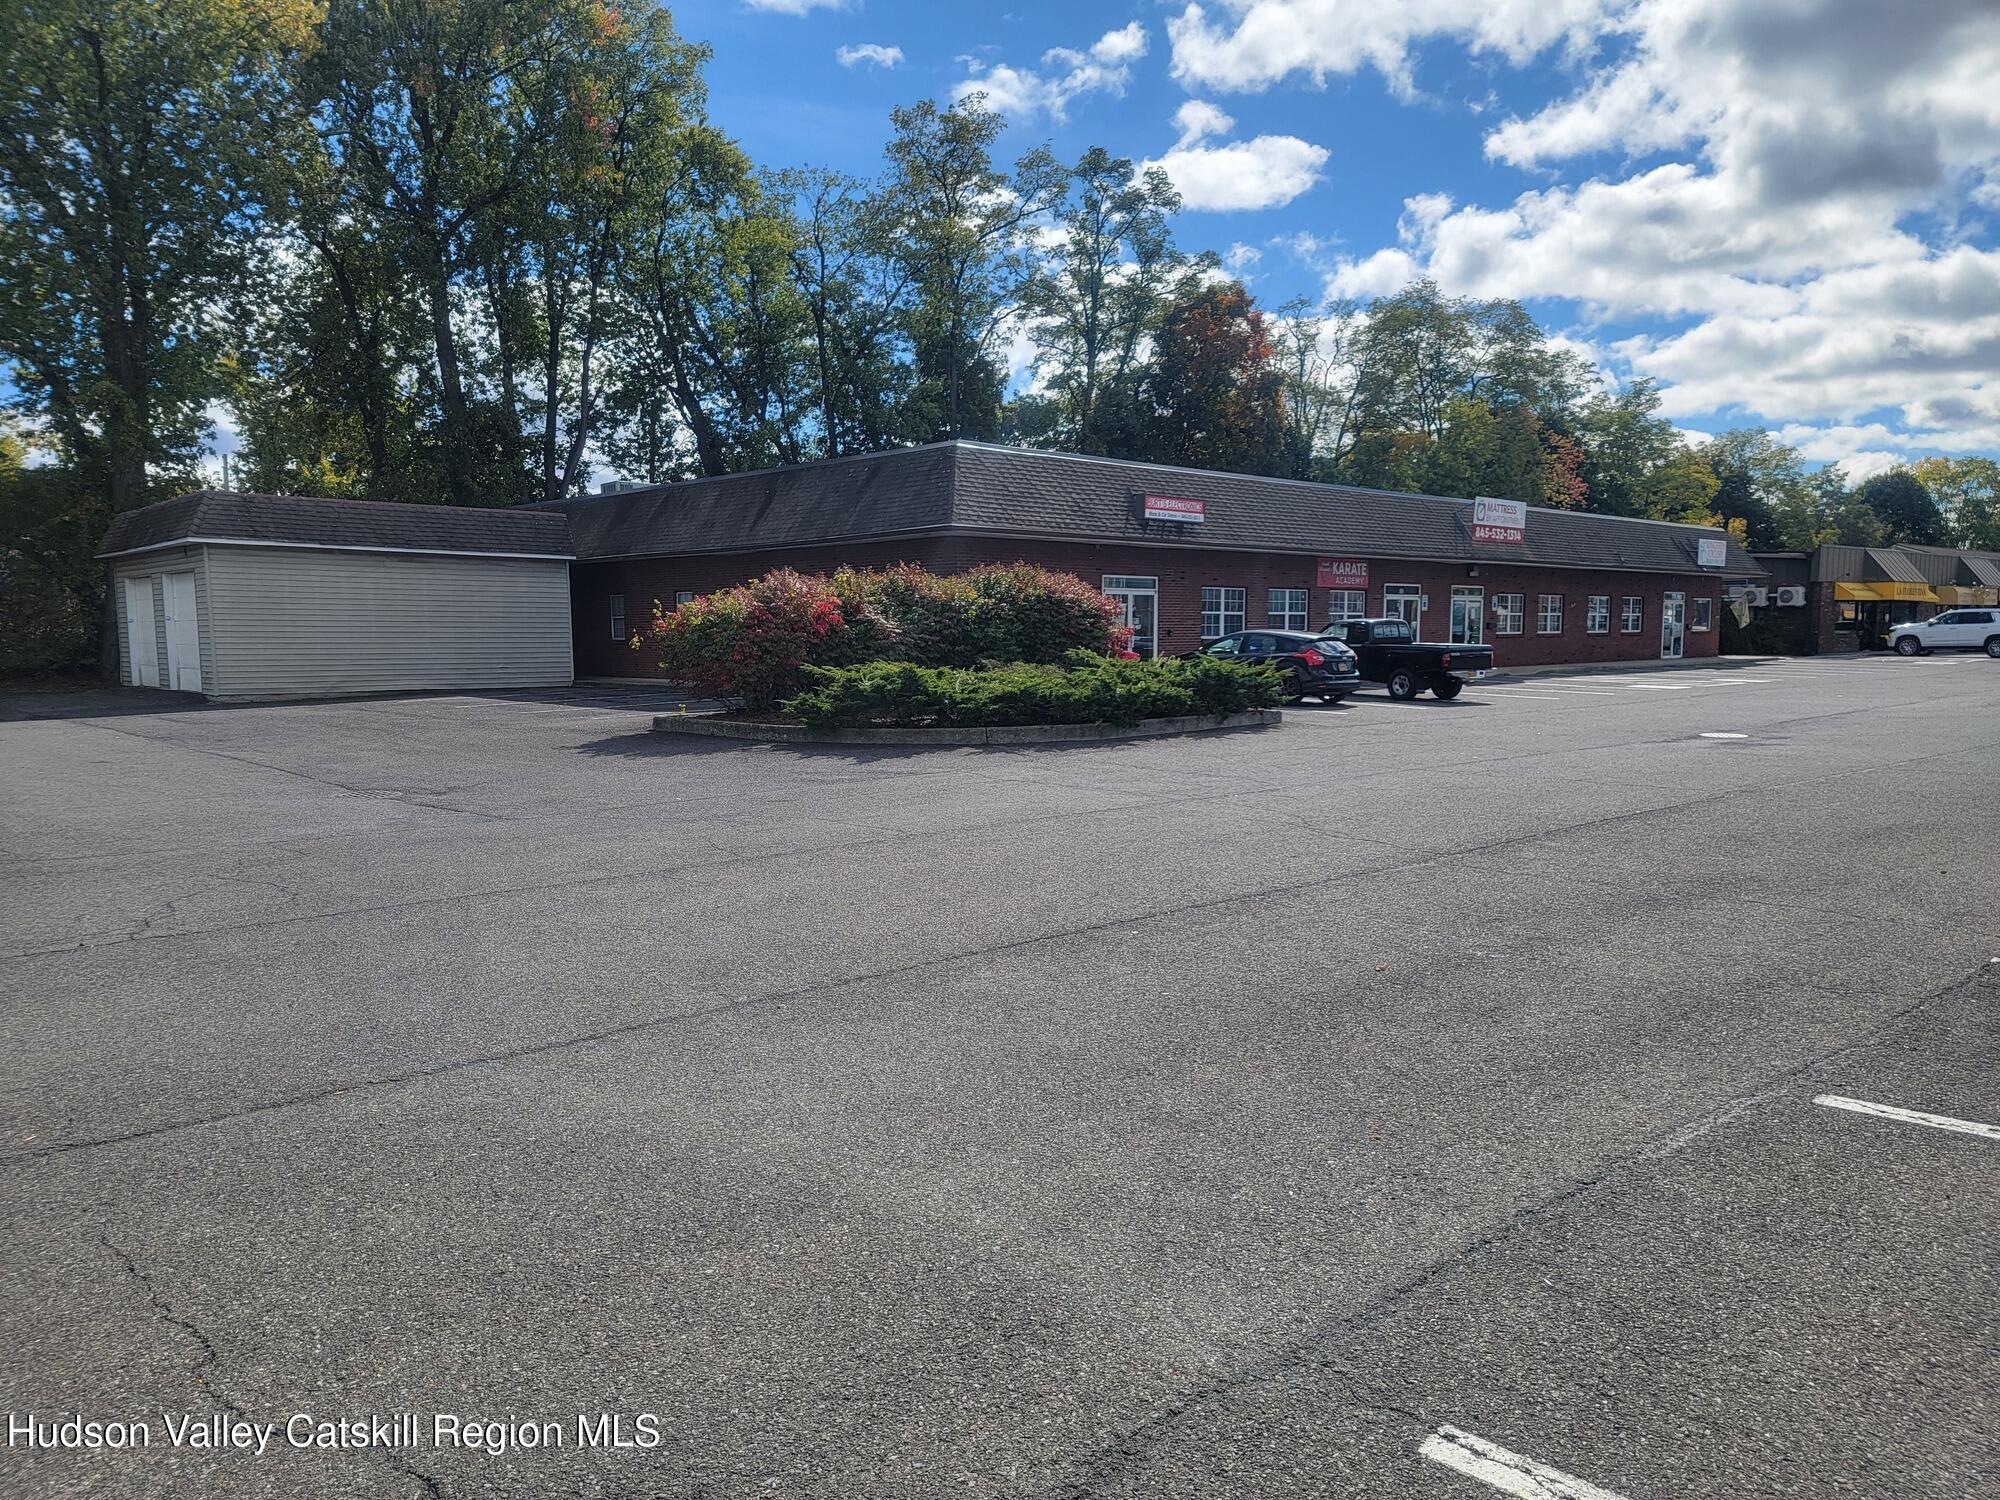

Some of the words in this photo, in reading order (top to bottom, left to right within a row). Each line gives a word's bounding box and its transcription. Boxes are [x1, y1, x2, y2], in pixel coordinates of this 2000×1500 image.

[1486, 502, 1518, 514] MATTRESS
[1475, 526, 1522, 541] 845-532-1314
[1332, 561, 1367, 576] KARATE
[1336, 576, 1364, 585] ACADEMY
